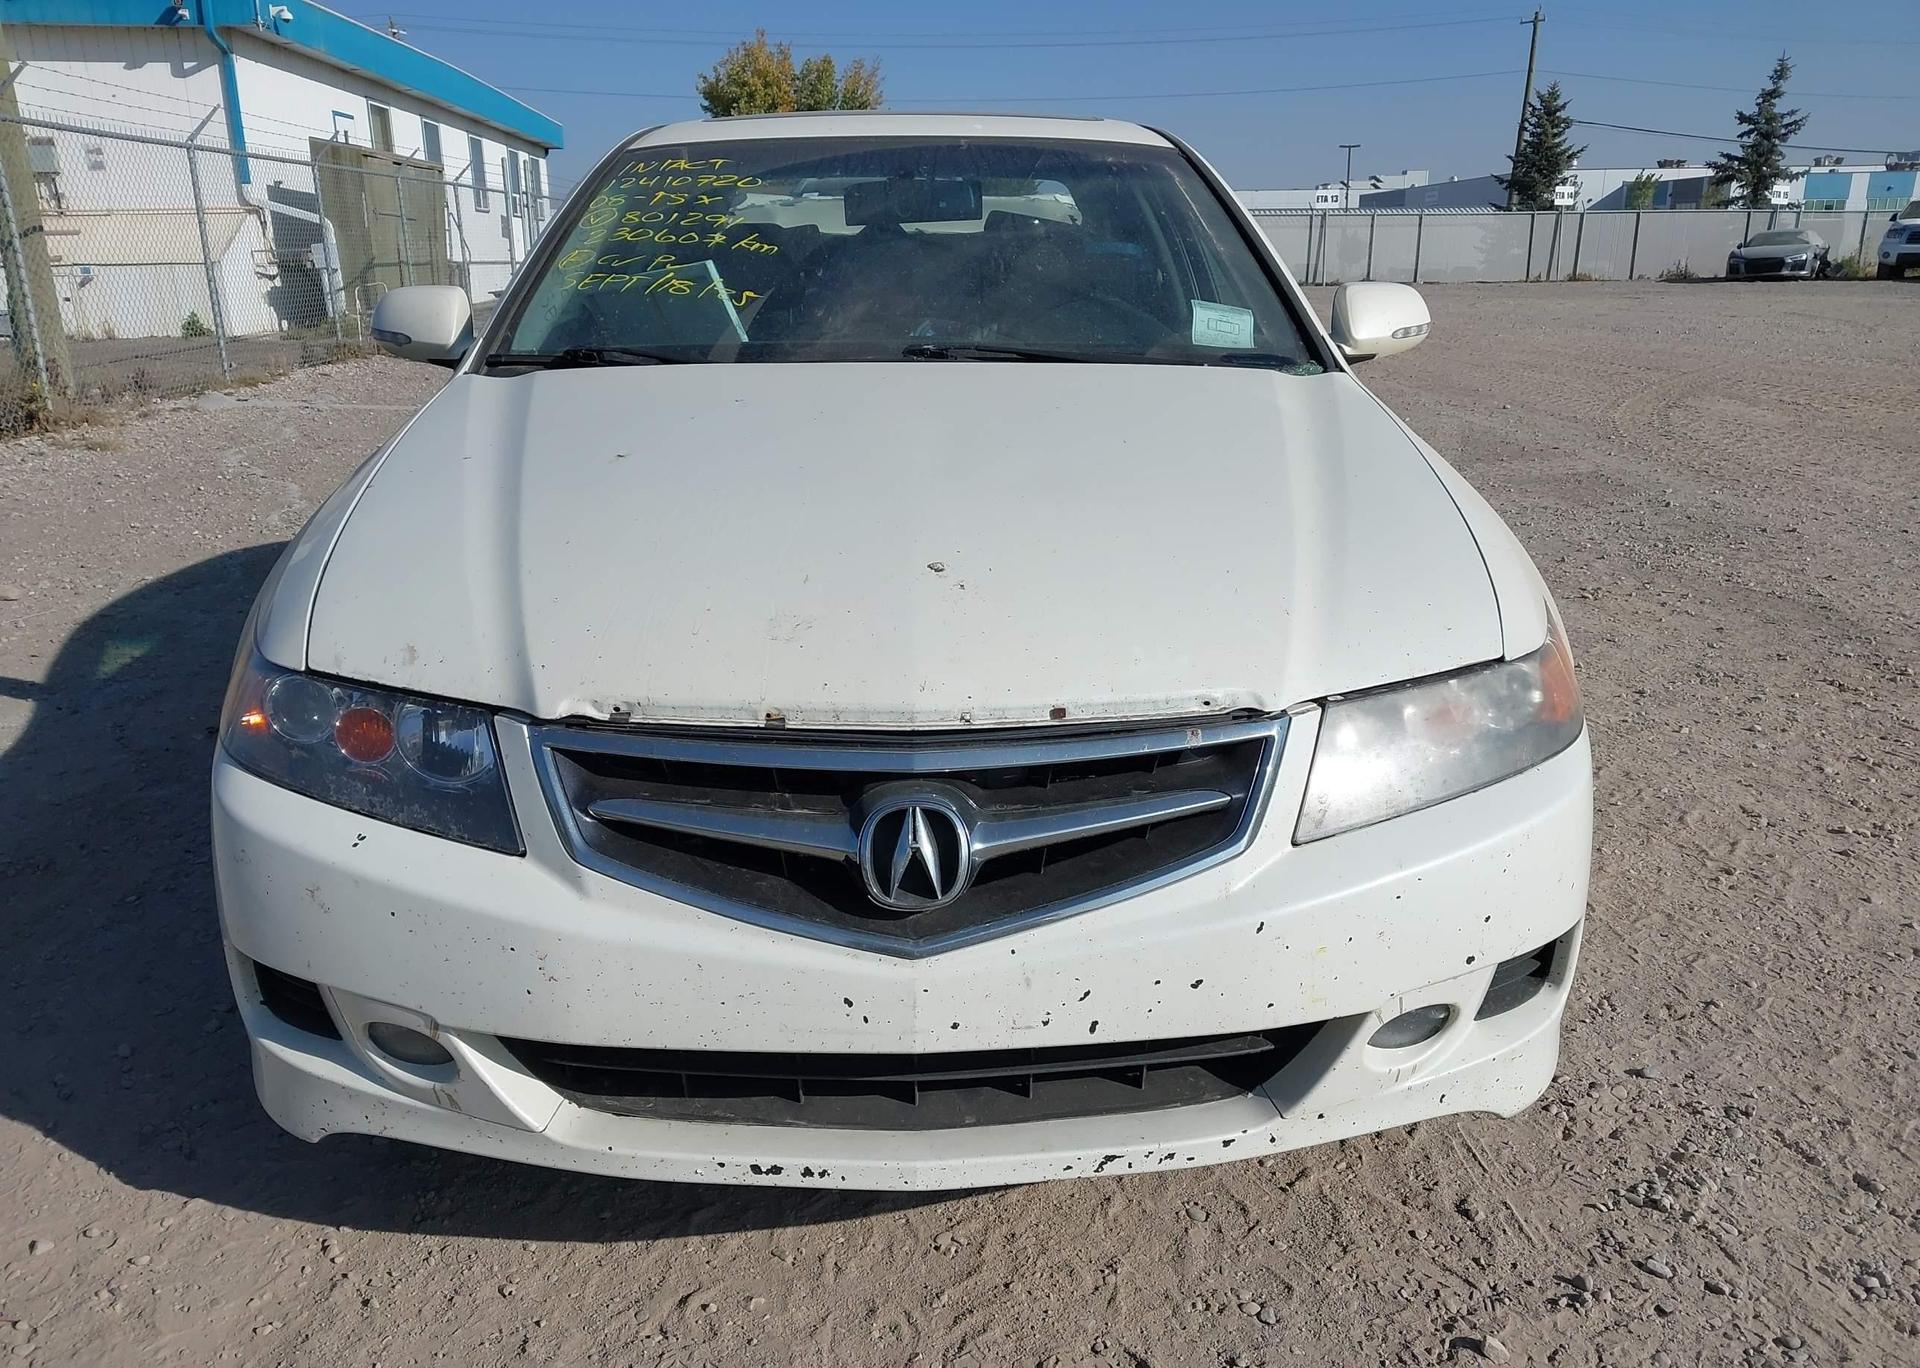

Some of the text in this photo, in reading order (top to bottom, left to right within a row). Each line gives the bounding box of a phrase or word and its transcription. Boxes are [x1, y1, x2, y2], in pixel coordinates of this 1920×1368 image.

[617, 158, 736, 177] INTACT
[603, 174, 763, 192] 12410720
[1316, 194, 1339, 203] ETA 13
